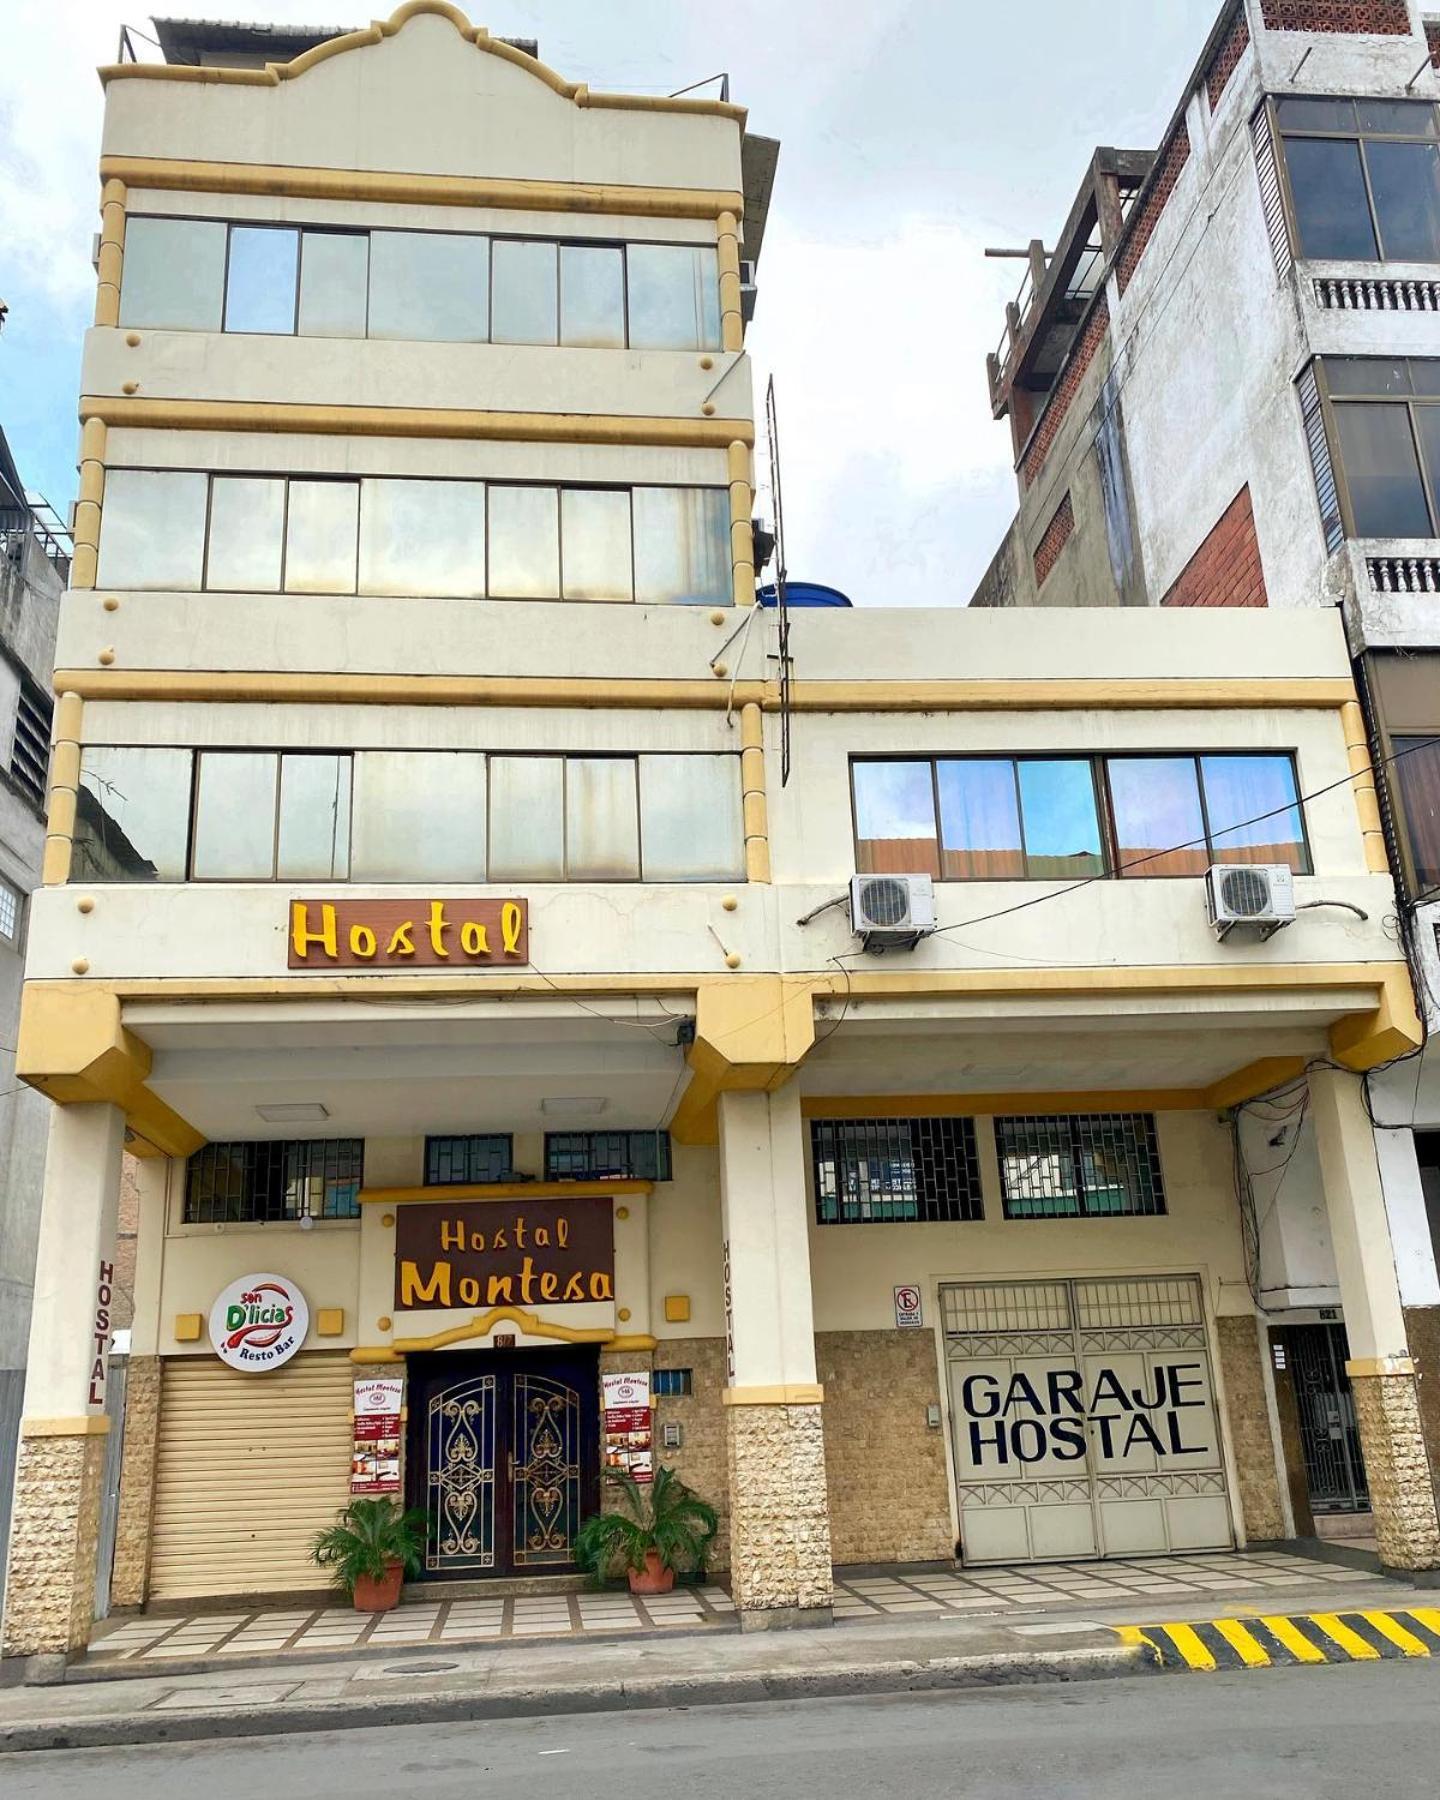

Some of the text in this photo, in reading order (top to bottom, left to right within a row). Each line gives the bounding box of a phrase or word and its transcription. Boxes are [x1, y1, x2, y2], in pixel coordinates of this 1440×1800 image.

[292, 901, 522, 957] Hostal
[440, 1217, 569, 1251] Hostal
[401, 1256, 614, 1306] Montesa
[723, 1239, 735, 1377] HOSTAL
[88, 1260, 114, 1404] HOSTAL
[240, 1336, 295, 1361] Resto Bar
[962, 1363, 1206, 1418] GARAJE
[969, 1410, 1209, 1466] HOSTAL
